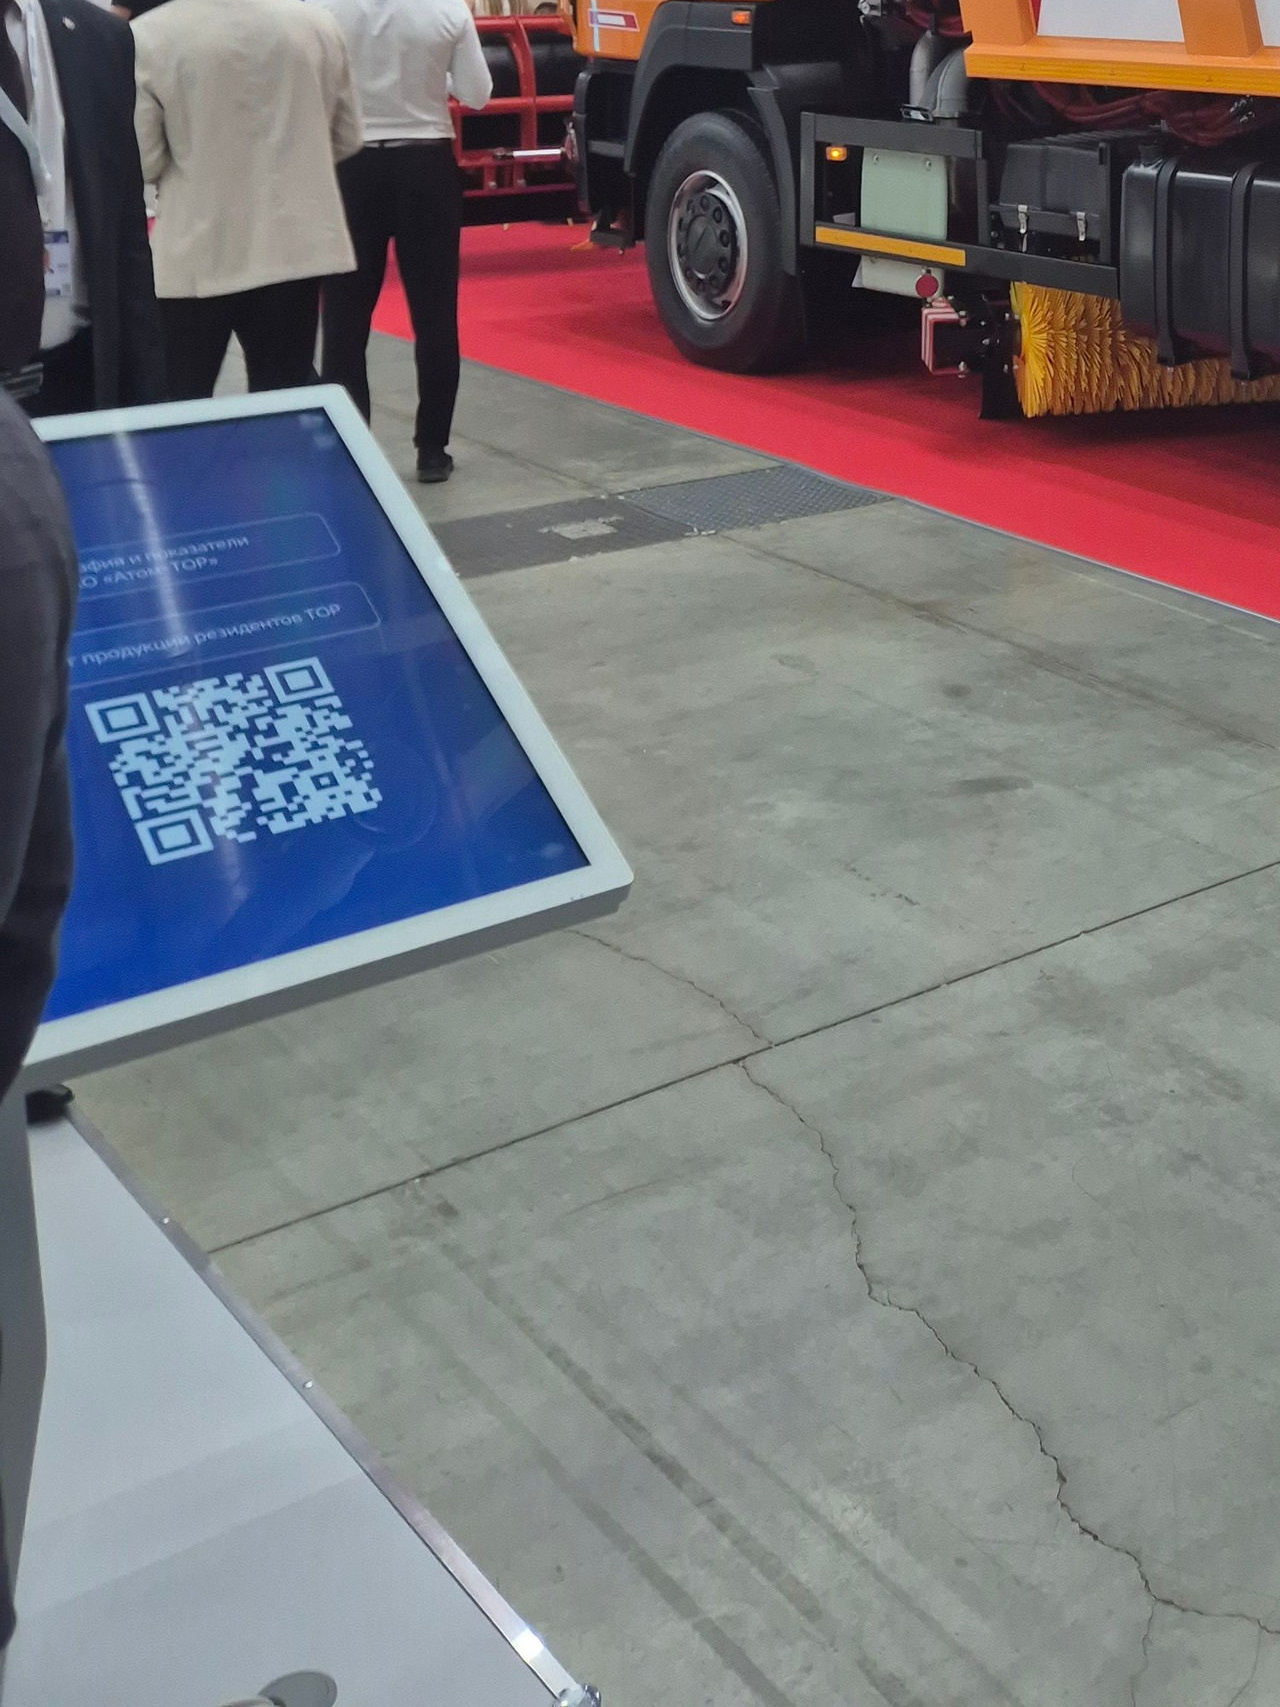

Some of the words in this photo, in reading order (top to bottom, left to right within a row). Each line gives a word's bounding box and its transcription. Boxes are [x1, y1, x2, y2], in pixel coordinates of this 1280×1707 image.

[103, 556, 218, 583] «АтомТОР»
[82, 635, 190, 665] продукции
[194, 614, 303, 645] резидентов
[304, 603, 341, 621] ТОР
